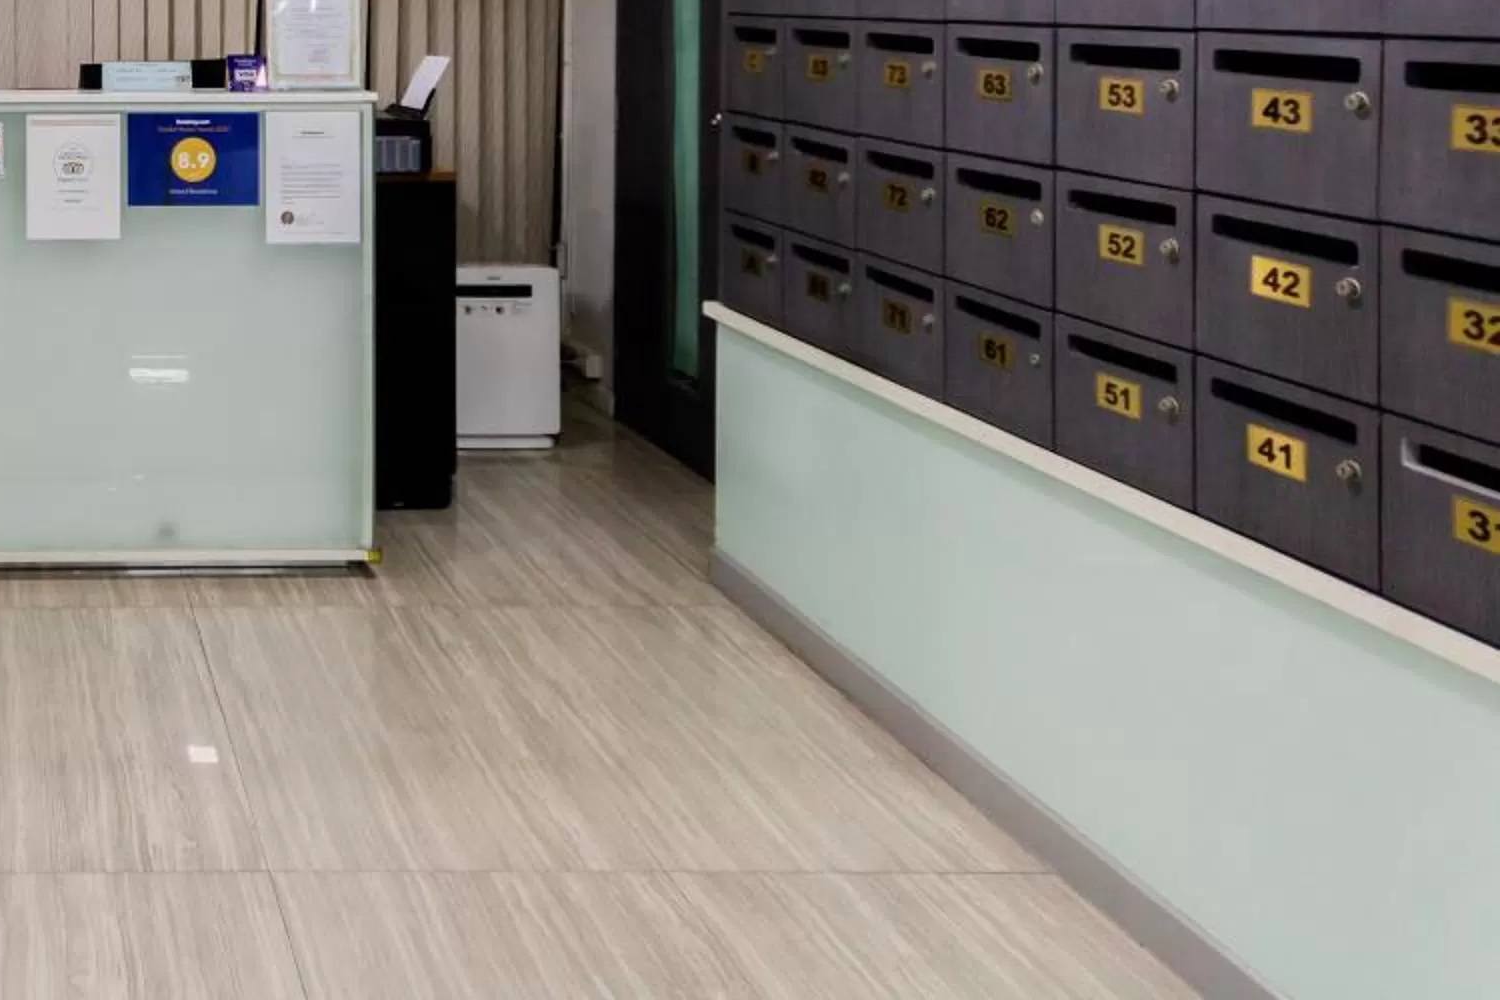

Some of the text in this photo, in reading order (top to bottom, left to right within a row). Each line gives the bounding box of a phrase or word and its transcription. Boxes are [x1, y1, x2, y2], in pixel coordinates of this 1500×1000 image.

[888, 65, 908, 85] 73
[983, 73, 1008, 96] 63
[1106, 83, 1137, 108] 53
[1262, 97, 1301, 125] 43
[178, 151, 210, 169] 8.9
[887, 184, 908, 207] 72
[984, 207, 1009, 231] 62
[1107, 232, 1136, 260] 52
[1262, 267, 1301, 300] 42
[889, 305, 908, 329] 71
[1462, 309, 1500, 345] 32
[984, 338, 1007, 365] 61
[1104, 381, 1131, 411] 51
[1257, 437, 1293, 470] 41
